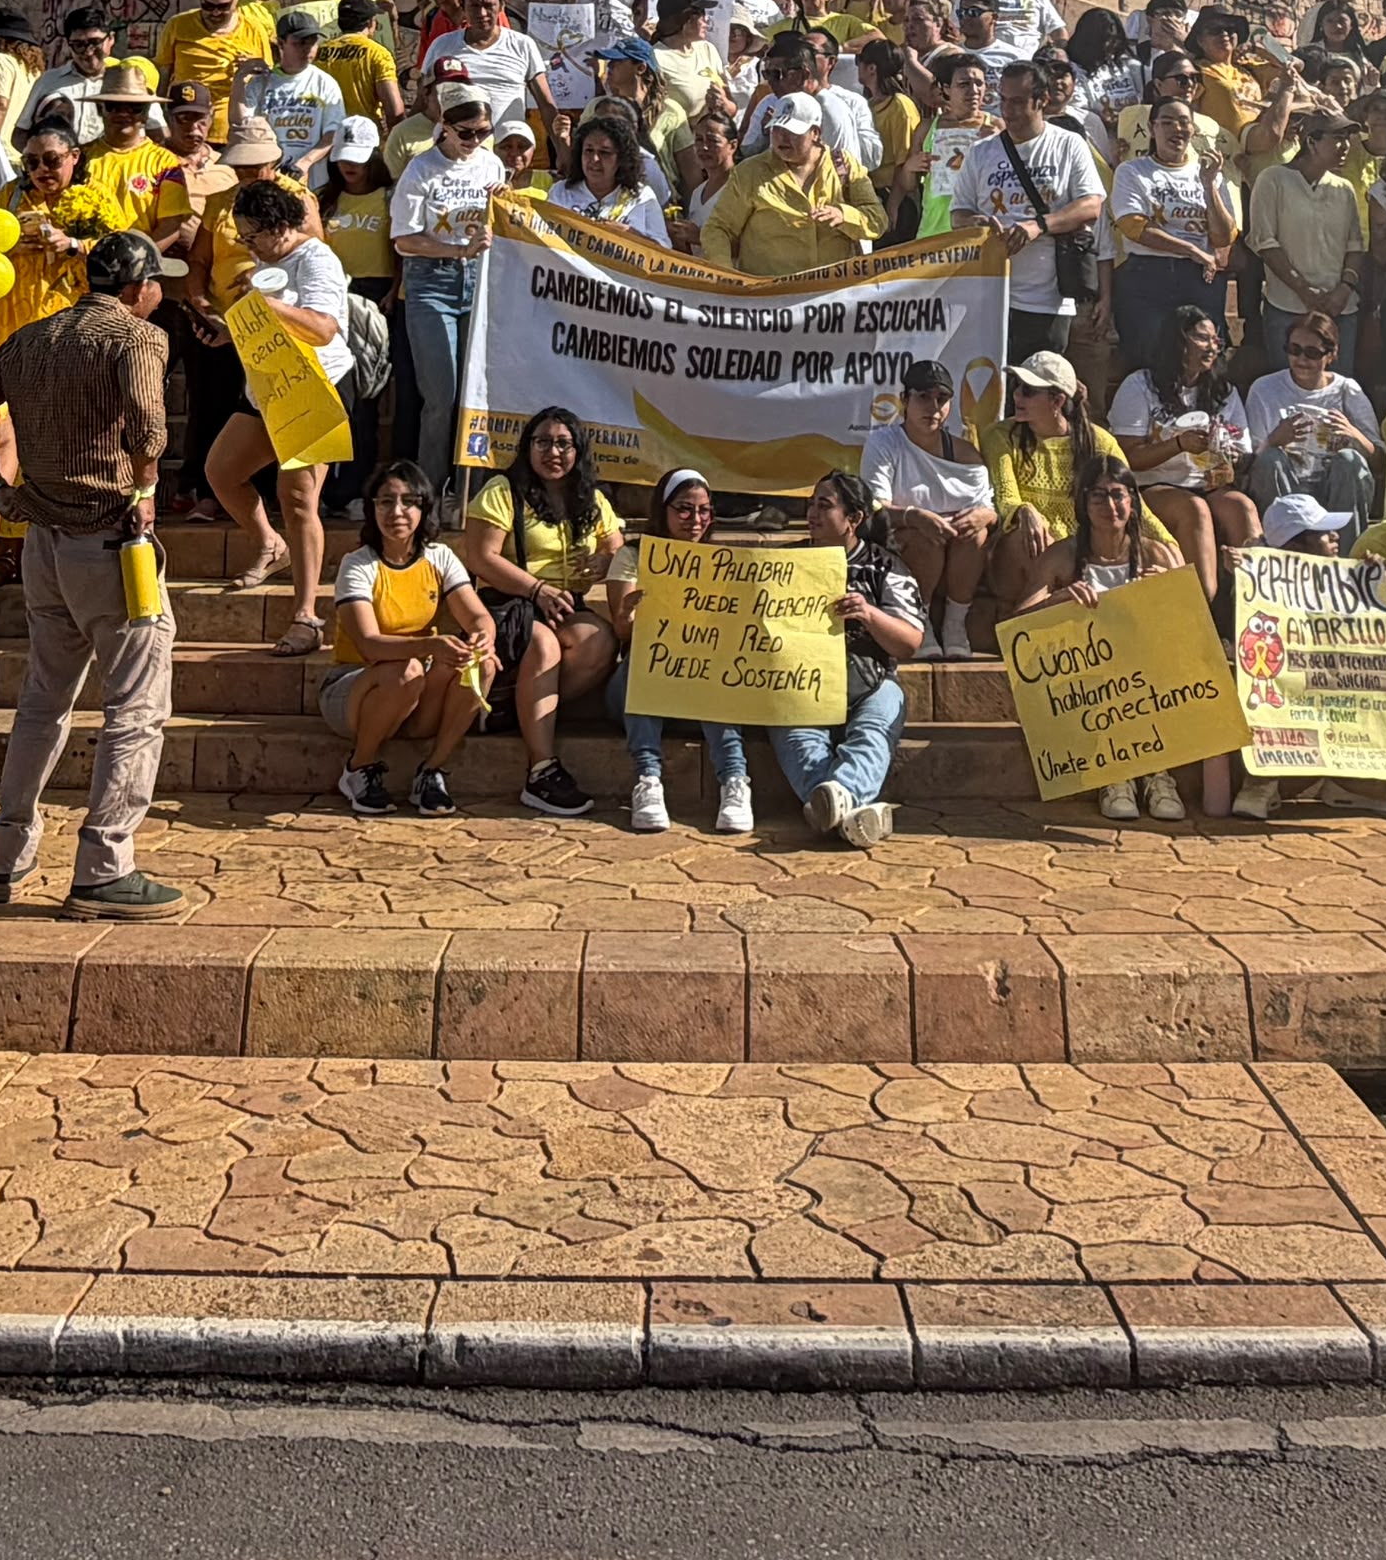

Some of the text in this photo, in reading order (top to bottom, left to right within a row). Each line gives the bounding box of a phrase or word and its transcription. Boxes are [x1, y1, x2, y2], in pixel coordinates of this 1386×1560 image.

[433, 186, 489, 202] esperan
[510, 208, 525, 226] ES
[568, 226, 588, 245] DE
[587, 235, 645, 267] CAMBIAR
[649, 257, 666, 273] LA
[853, 260, 869, 276] SE
[873, 252, 916, 274] PUEDE
[920, 244, 982, 265] PREVENIR
[531, 265, 946, 334] CAMBIEMOS EL SILENCIO POR ESCUCHA
[551, 321, 913, 385] CAMBIEMOS SOLEDAD POR APOYO
[648, 542, 795, 587] UNA PALABRA
[683, 587, 829, 621] PUEDE ACERCAR
[682, 623, 720, 651] UNA
[739, 624, 783, 653] RED
[1012, 621, 1113, 684] Cuando
[1286, 617, 1386, 647] AMARILLO
[649, 643, 822, 702] PUEDE SOSTENER
[1312, 673, 1328, 688] del
[1323, 655, 1336, 670] la
[1046, 670, 1146, 717] hablamos
[1037, 724, 1165, 782] Únete a la red
